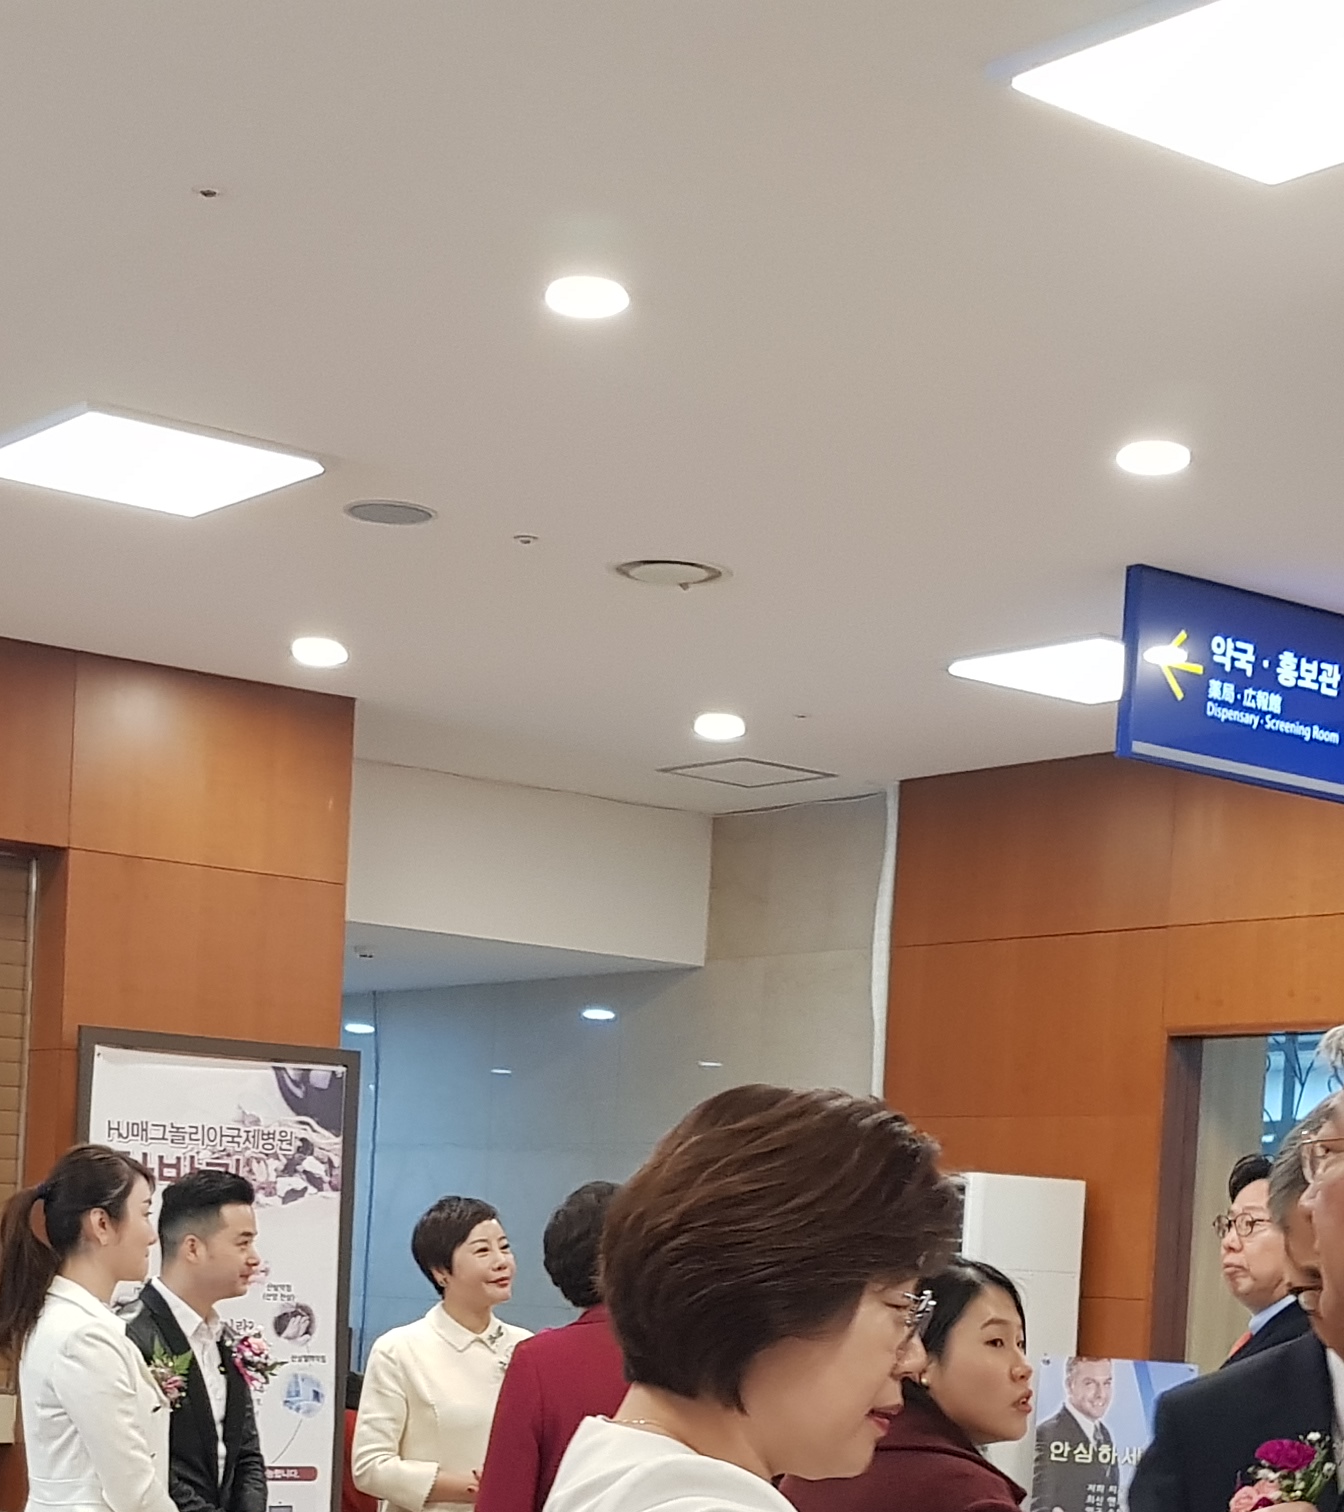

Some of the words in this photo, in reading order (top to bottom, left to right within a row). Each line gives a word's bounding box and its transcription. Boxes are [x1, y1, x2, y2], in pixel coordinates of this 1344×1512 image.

[1211, 636, 1255, 678] 약국
[1276, 650, 1341, 697] 홍보관
[1312, 724, 1340, 744] Room
[107, 1120, 294, 1152] HJ매그놀리아국제병원
